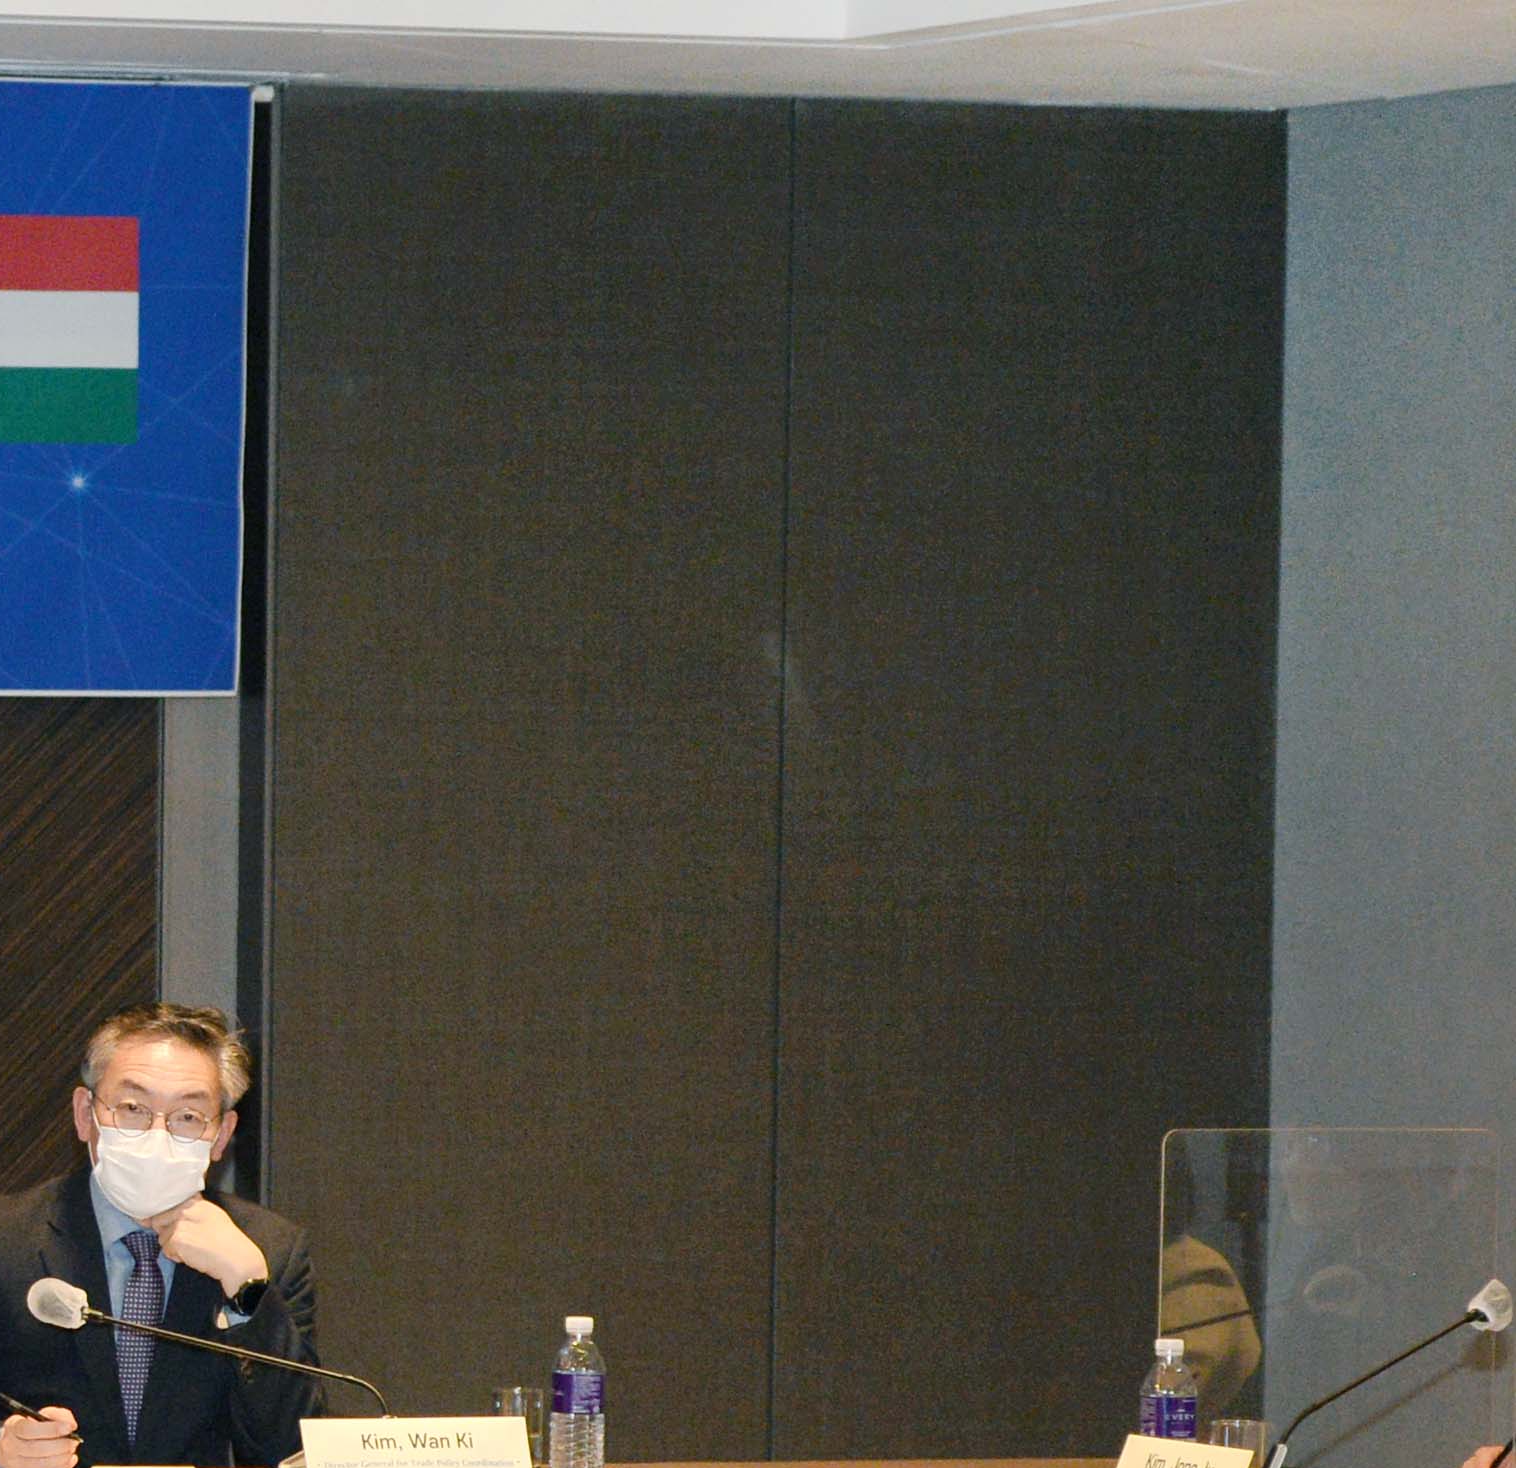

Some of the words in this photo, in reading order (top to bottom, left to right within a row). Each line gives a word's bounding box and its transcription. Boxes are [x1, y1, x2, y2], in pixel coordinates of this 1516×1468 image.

[362, 1434, 402, 1450] Kim,
[408, 1433, 449, 1448] Wan
[456, 1433, 473, 1448] Ki
